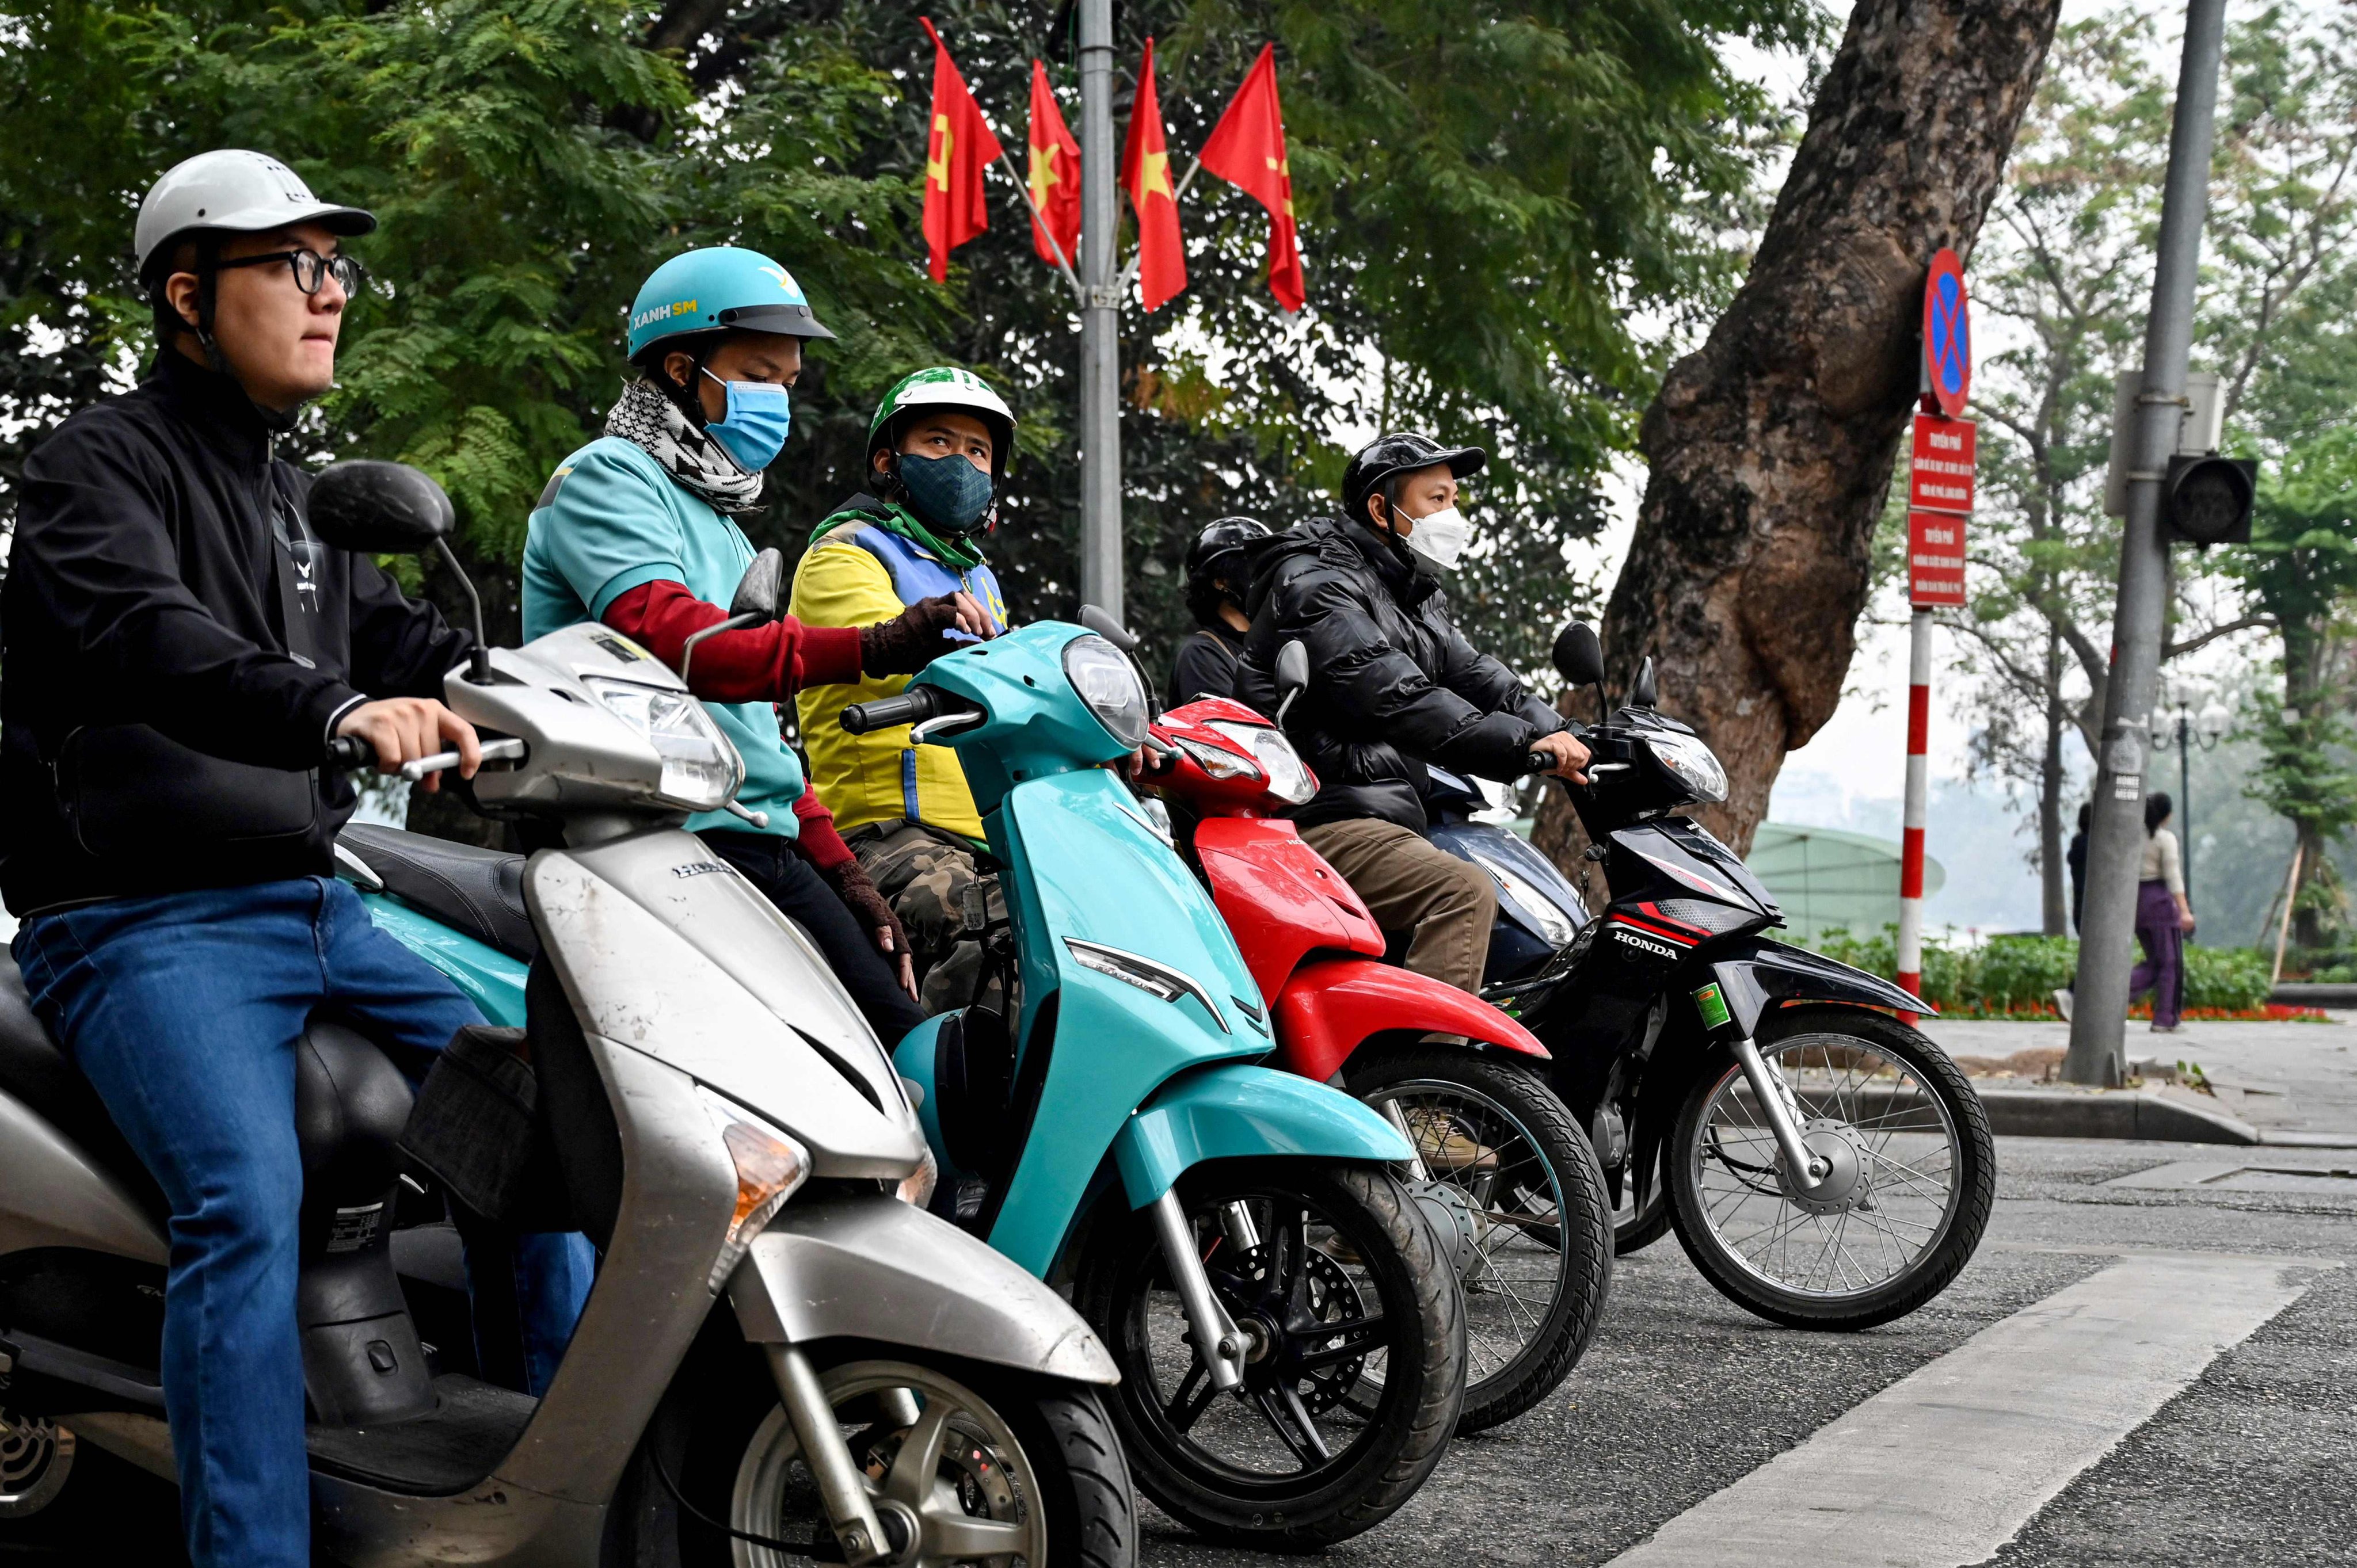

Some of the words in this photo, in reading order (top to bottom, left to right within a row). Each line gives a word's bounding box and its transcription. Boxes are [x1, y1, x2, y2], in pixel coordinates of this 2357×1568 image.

[634, 304, 671, 331] XANH
[672, 299, 698, 316] SM
[1613, 930, 1678, 960] HONDA
